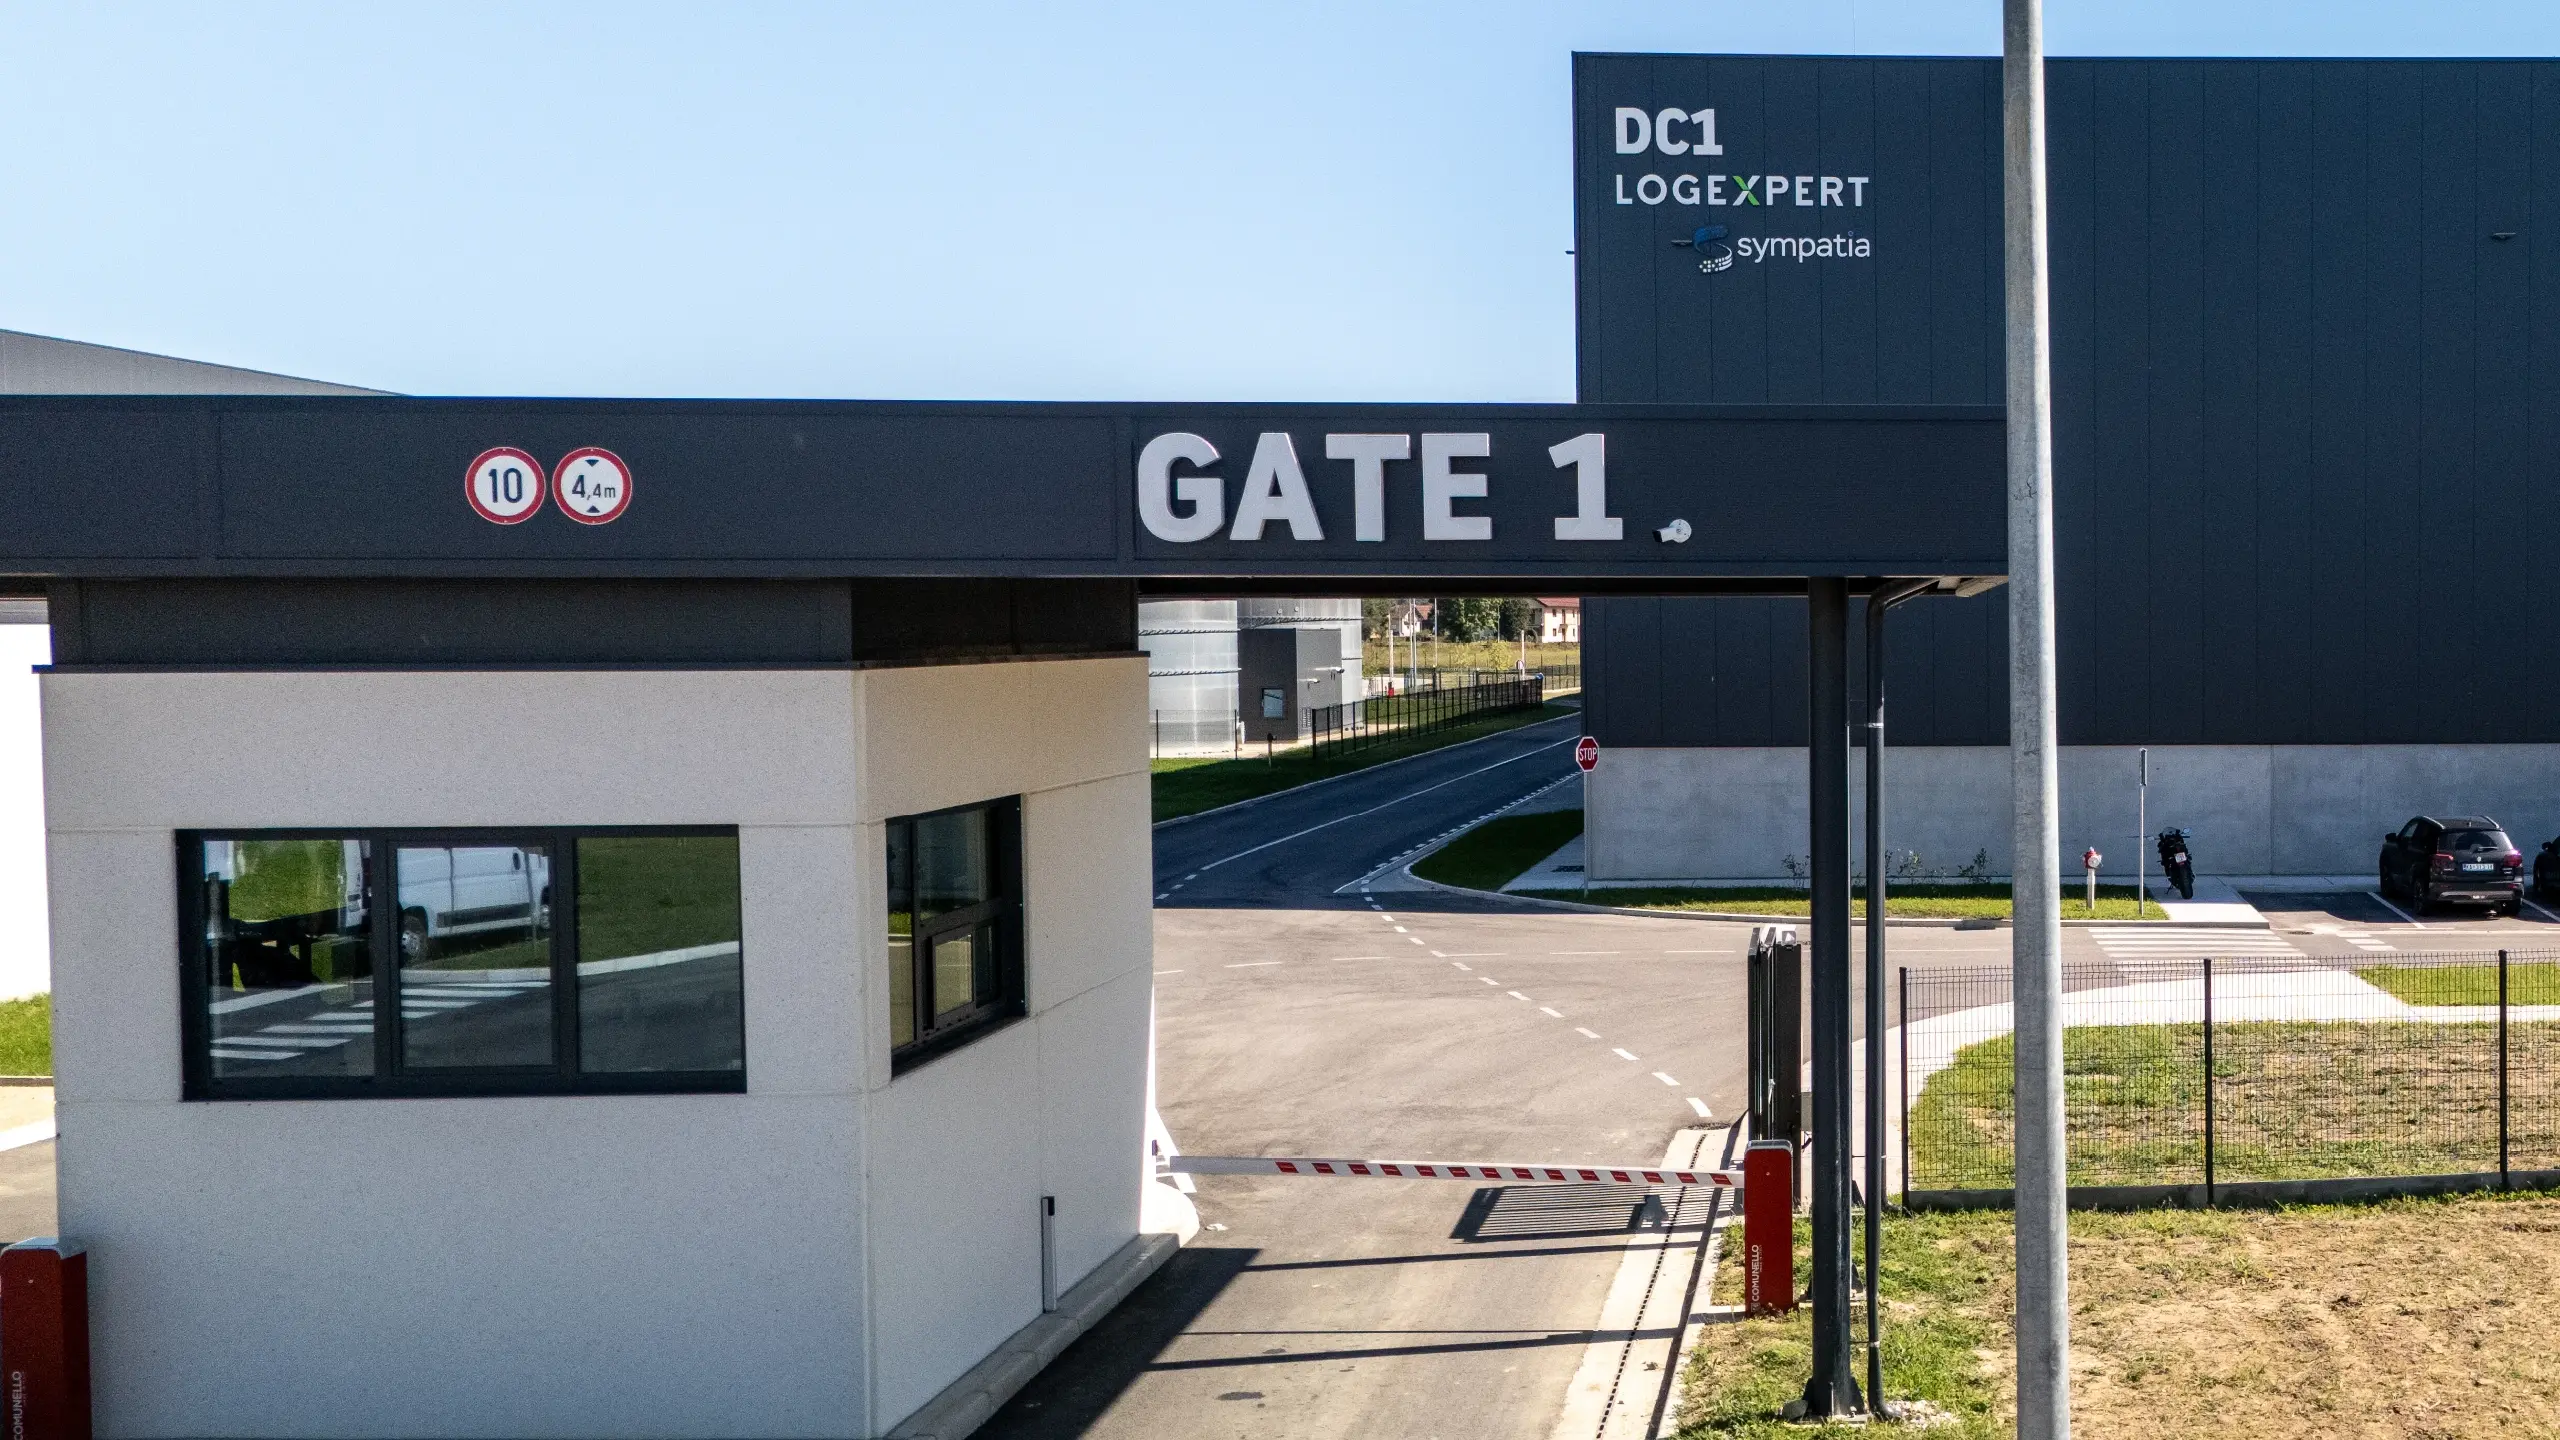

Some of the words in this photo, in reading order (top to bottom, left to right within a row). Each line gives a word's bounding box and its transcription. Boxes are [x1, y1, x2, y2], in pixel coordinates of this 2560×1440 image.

[1615, 107, 1723, 156] DC1
[1615, 174, 1869, 207] LOGEXPERT
[1737, 231, 1871, 263] sympatia
[489, 468, 523, 503] 10
[1138, 432, 1493, 543] GATE
[1548, 433, 1624, 541] 1
[1579, 748, 1598, 761] STOP
[1751, 1244, 1760, 1301] COMUNELLO
